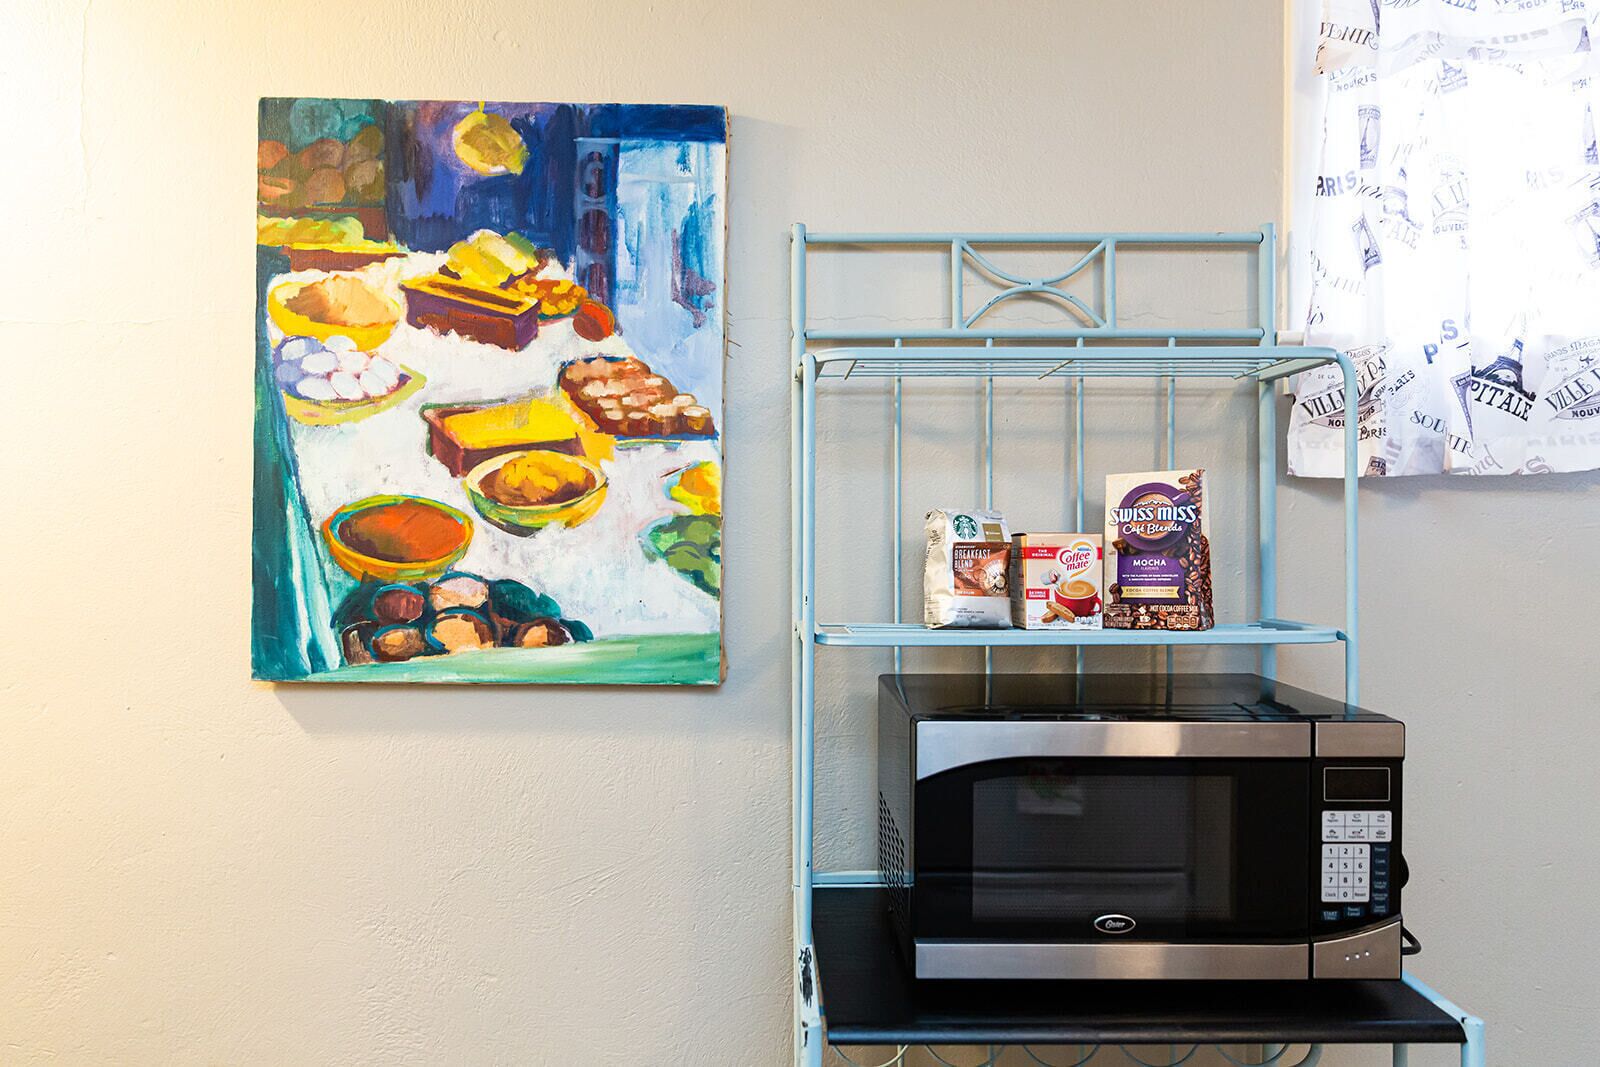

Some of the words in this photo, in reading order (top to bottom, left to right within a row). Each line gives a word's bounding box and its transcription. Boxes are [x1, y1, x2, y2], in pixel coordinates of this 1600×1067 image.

[1544, 377, 1593, 412] VILLE
[1109, 507, 1154, 526] SWISS
[1157, 504, 1197, 523] MISS
[1147, 520, 1182, 534] Blends
[954, 549, 991, 560] BREAKFAST
[1059, 549, 1091, 565] Coffee
[954, 559, 974, 569] BLEND
[1066, 560, 1089, 571] mate
[1132, 559, 1167, 567] MOCHA
[1328, 876, 1333, 884] 7
[1343, 876, 1348, 884] 8
[1358, 876, 1363, 884] 9
